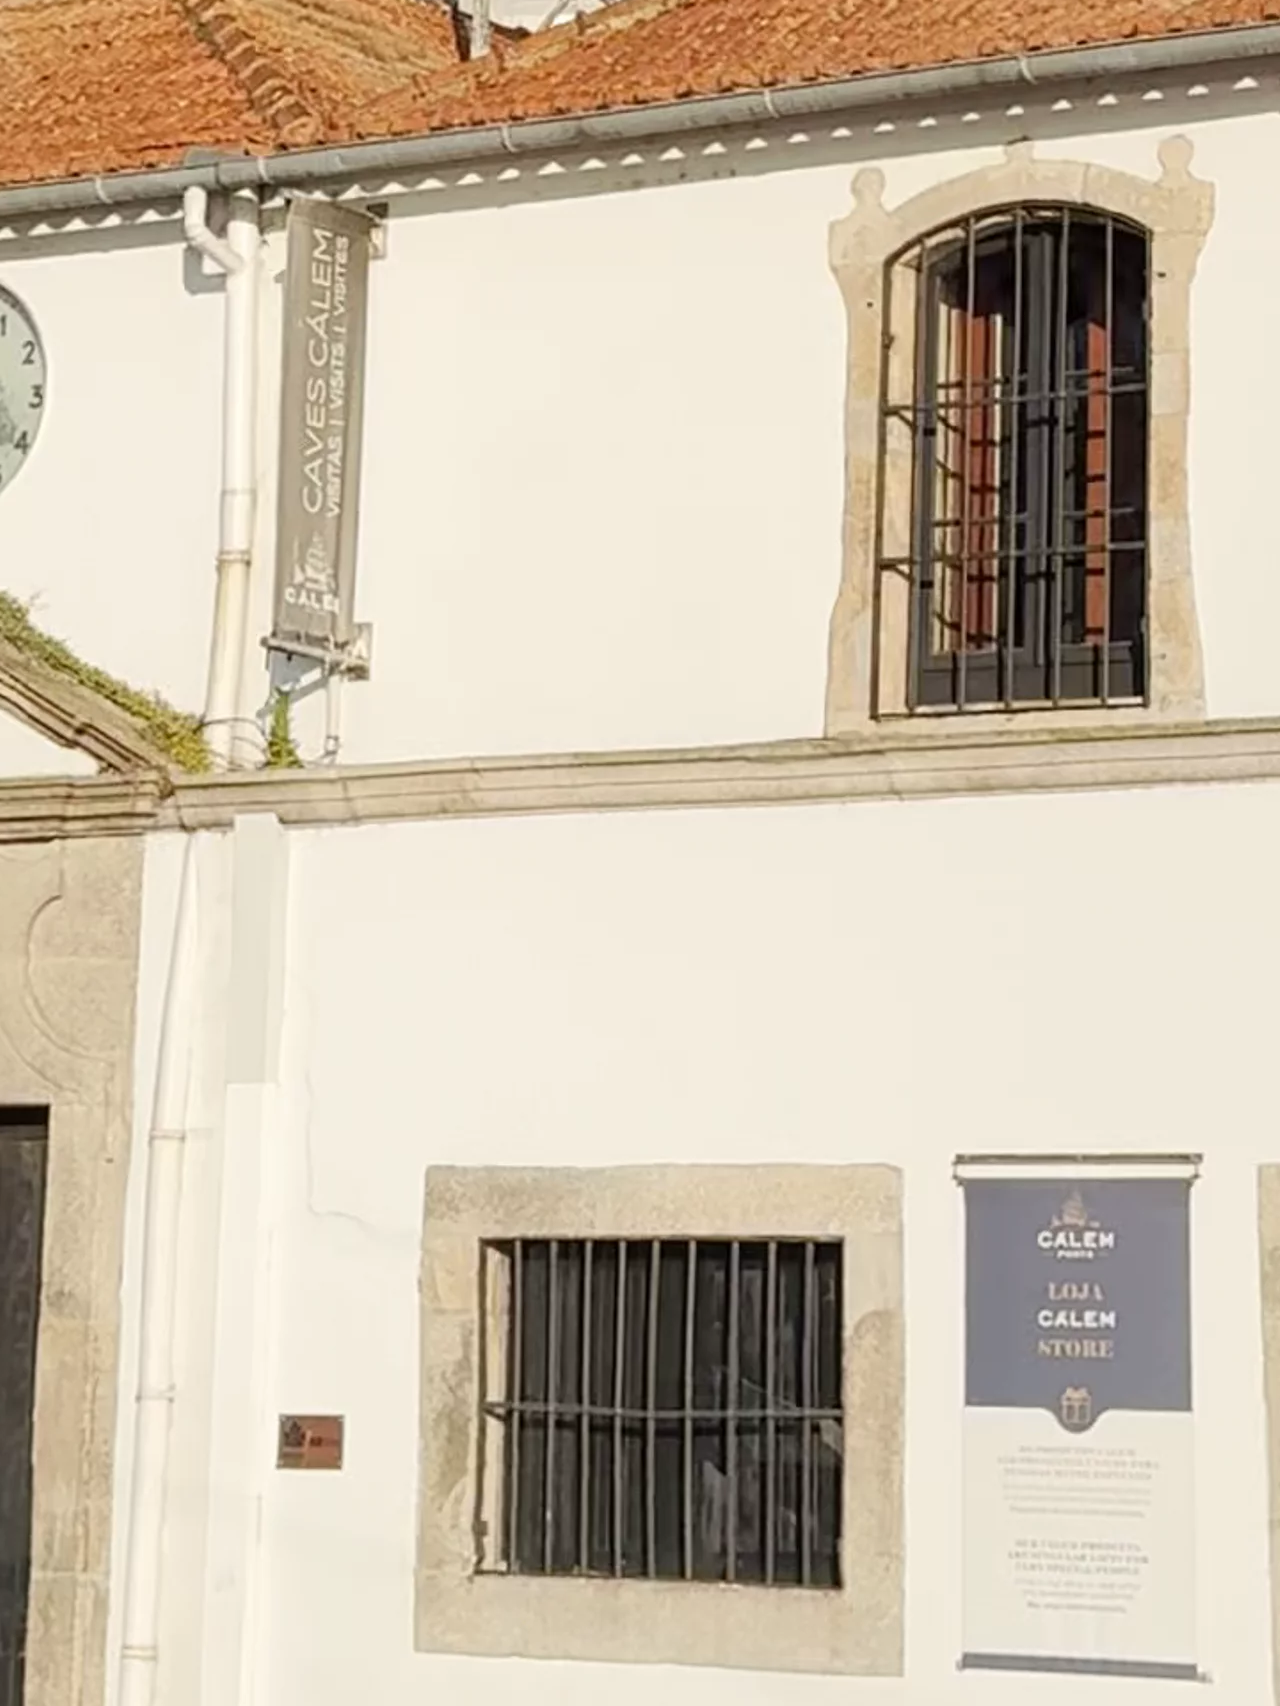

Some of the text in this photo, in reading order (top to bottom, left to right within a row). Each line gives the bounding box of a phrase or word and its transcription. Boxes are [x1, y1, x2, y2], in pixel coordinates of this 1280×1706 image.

[332, 235, 350, 317] VISITES
[0, 314, 8, 336] 1
[22, 340, 36, 365] 2
[328, 341, 347, 409] VISITS
[28, 384, 43, 408] 3
[13, 430, 30, 455] 4
[302, 377, 327, 514] CAVES
[324, 436, 343, 518] VISITAS
[1048, 1281, 1104, 1302] LOJA
[1037, 1339, 1115, 1359] STORE
